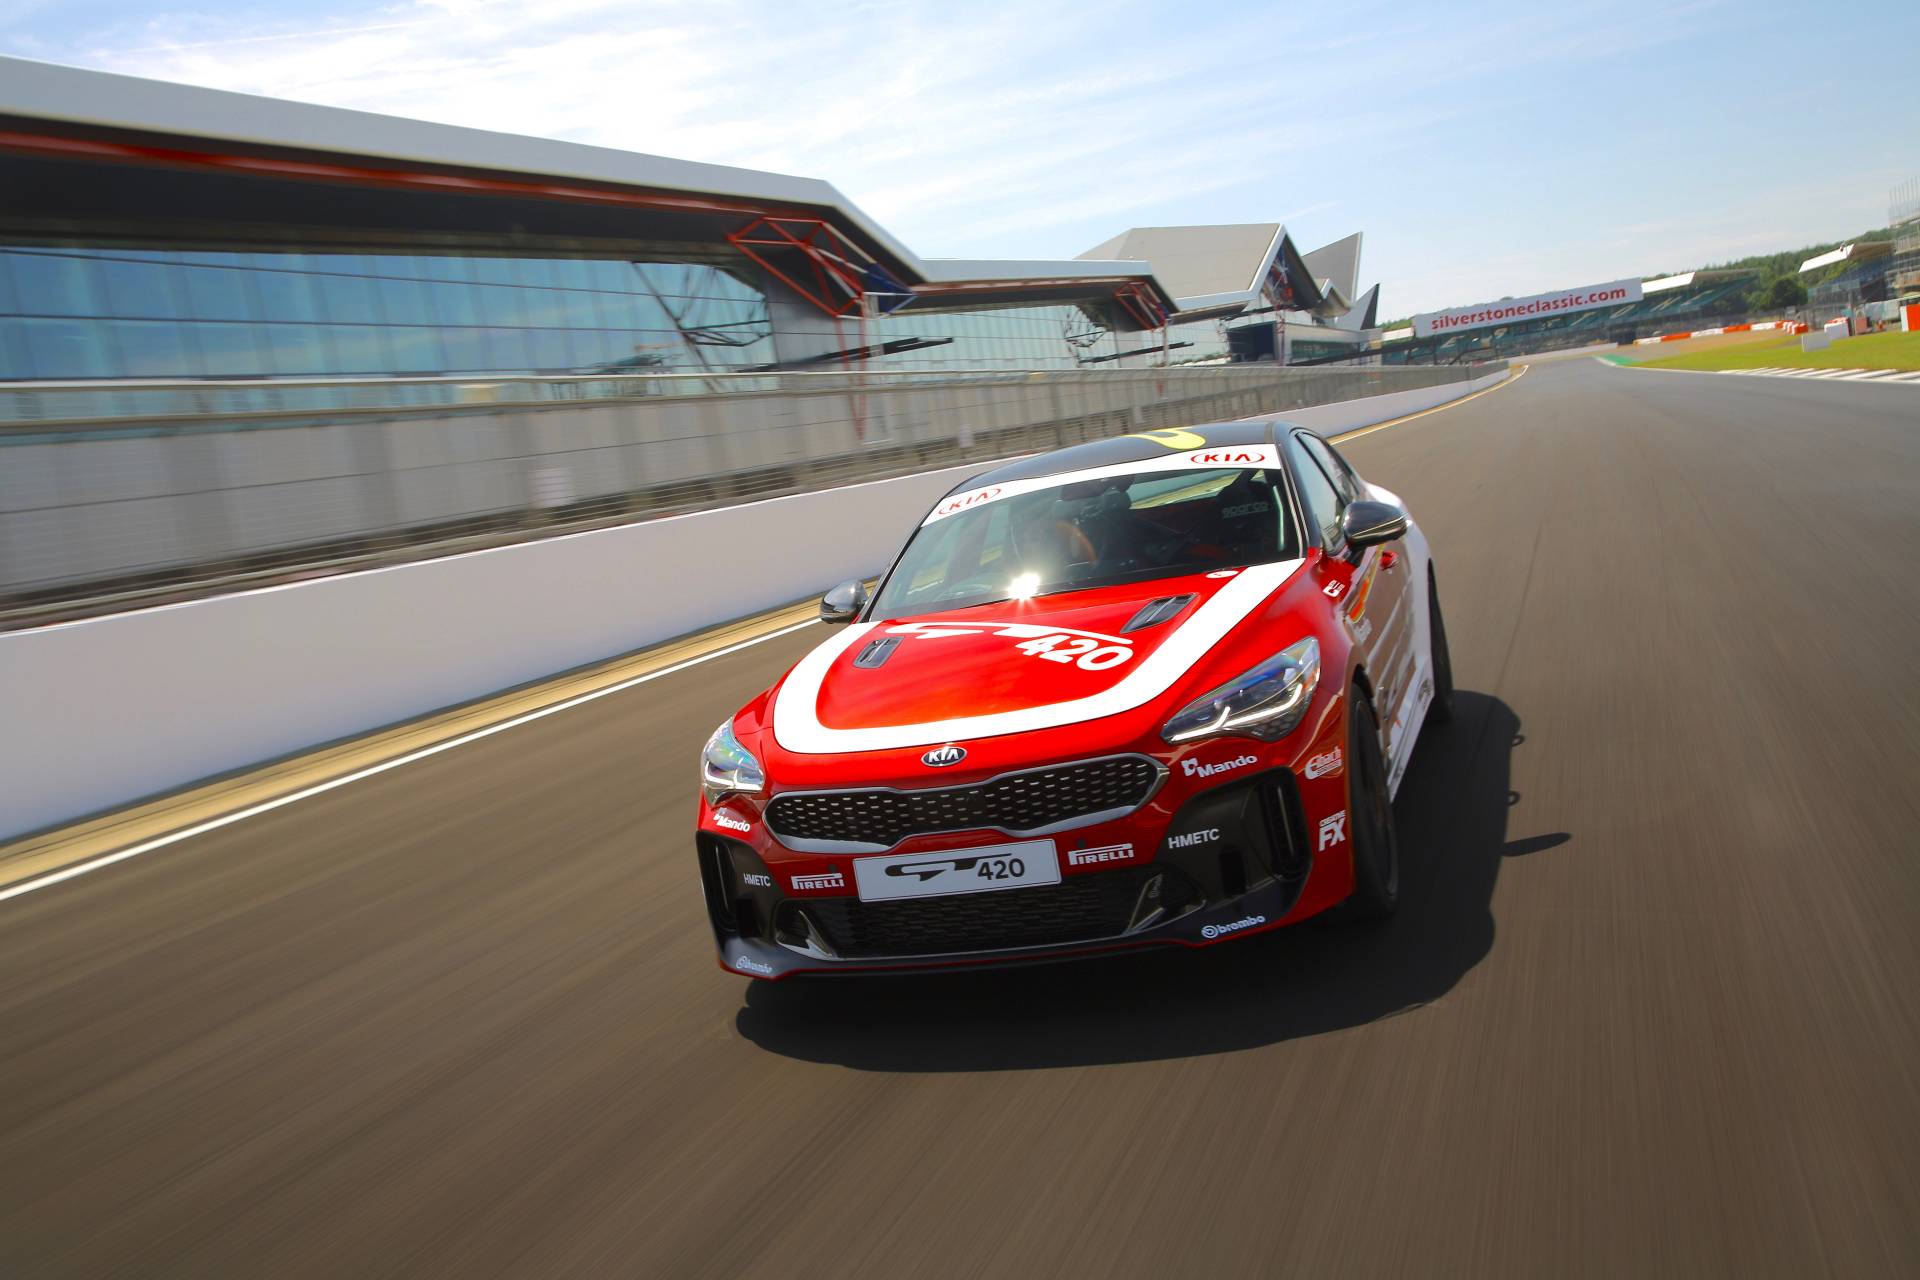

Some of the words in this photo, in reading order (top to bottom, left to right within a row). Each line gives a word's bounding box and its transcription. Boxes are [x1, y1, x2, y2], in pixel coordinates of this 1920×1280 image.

[1431, 287, 1627, 330] silverstoneclassic.com
[949, 492, 988, 511] KIA
[1015, 634, 1133, 671] 420
[1197, 755, 1258, 778] Mando
[717, 816, 751, 833] Mando
[1318, 816, 1346, 852] FX
[1167, 828, 1220, 849] HMETC
[1067, 842, 1135, 866] PIRELLI
[743, 872, 771, 887] HMETC
[977, 858, 1025, 881] 420
[790, 872, 845, 890] PIRELLI
[1217, 915, 1266, 934] brembo
